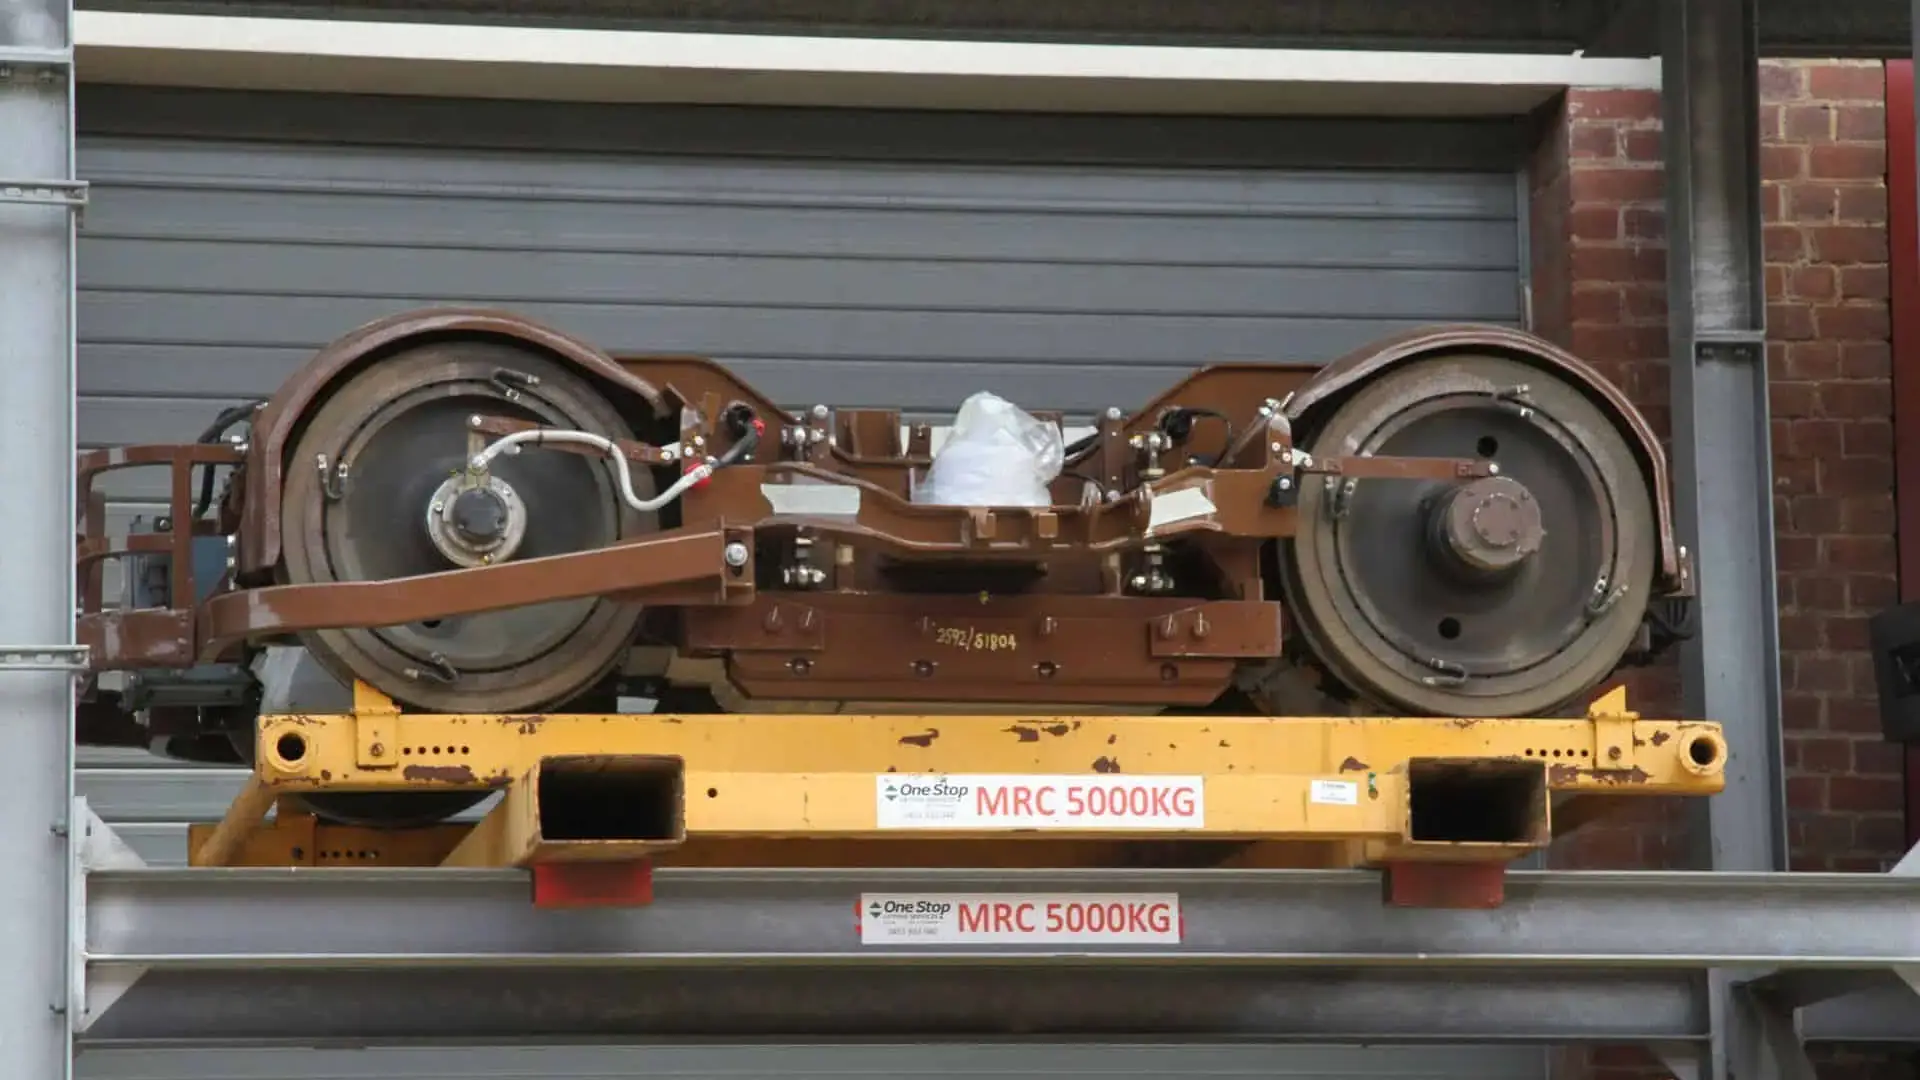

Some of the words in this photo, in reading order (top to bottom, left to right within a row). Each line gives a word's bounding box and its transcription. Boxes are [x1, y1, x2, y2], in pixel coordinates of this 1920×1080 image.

[900, 783, 930, 796] One
[933, 783, 969, 801] Stop
[976, 786, 1056, 816] MRC
[1067, 786, 1196, 817] 5000KG
[883, 900, 914, 913] One
[916, 900, 951, 918] Stop
[958, 903, 1035, 932] MRC
[1046, 903, 1171, 932] 5000KG
